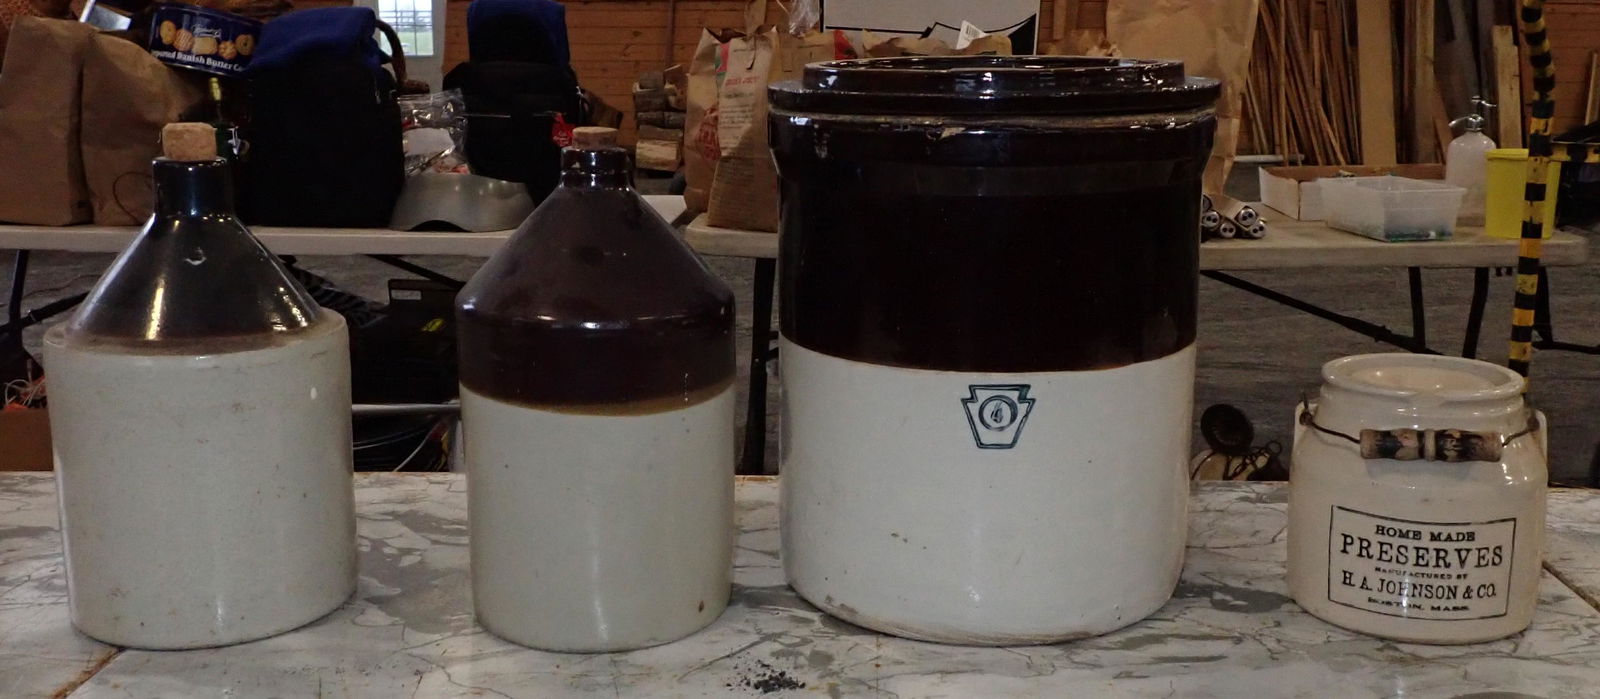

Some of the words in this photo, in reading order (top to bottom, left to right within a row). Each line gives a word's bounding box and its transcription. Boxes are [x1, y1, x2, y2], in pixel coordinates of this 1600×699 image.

[176, 51, 205, 64] Danish
[206, 57, 232, 69] Butter
[1375, 524, 1422, 541] HOME
[1429, 531, 1476, 542] MADE
[1340, 533, 1504, 570] PRESERVES
[1374, 566, 1453, 580] MANUFACTURED
[1376, 578, 1459, 600] JOHNSON
[1462, 585, 1474, 600] &
